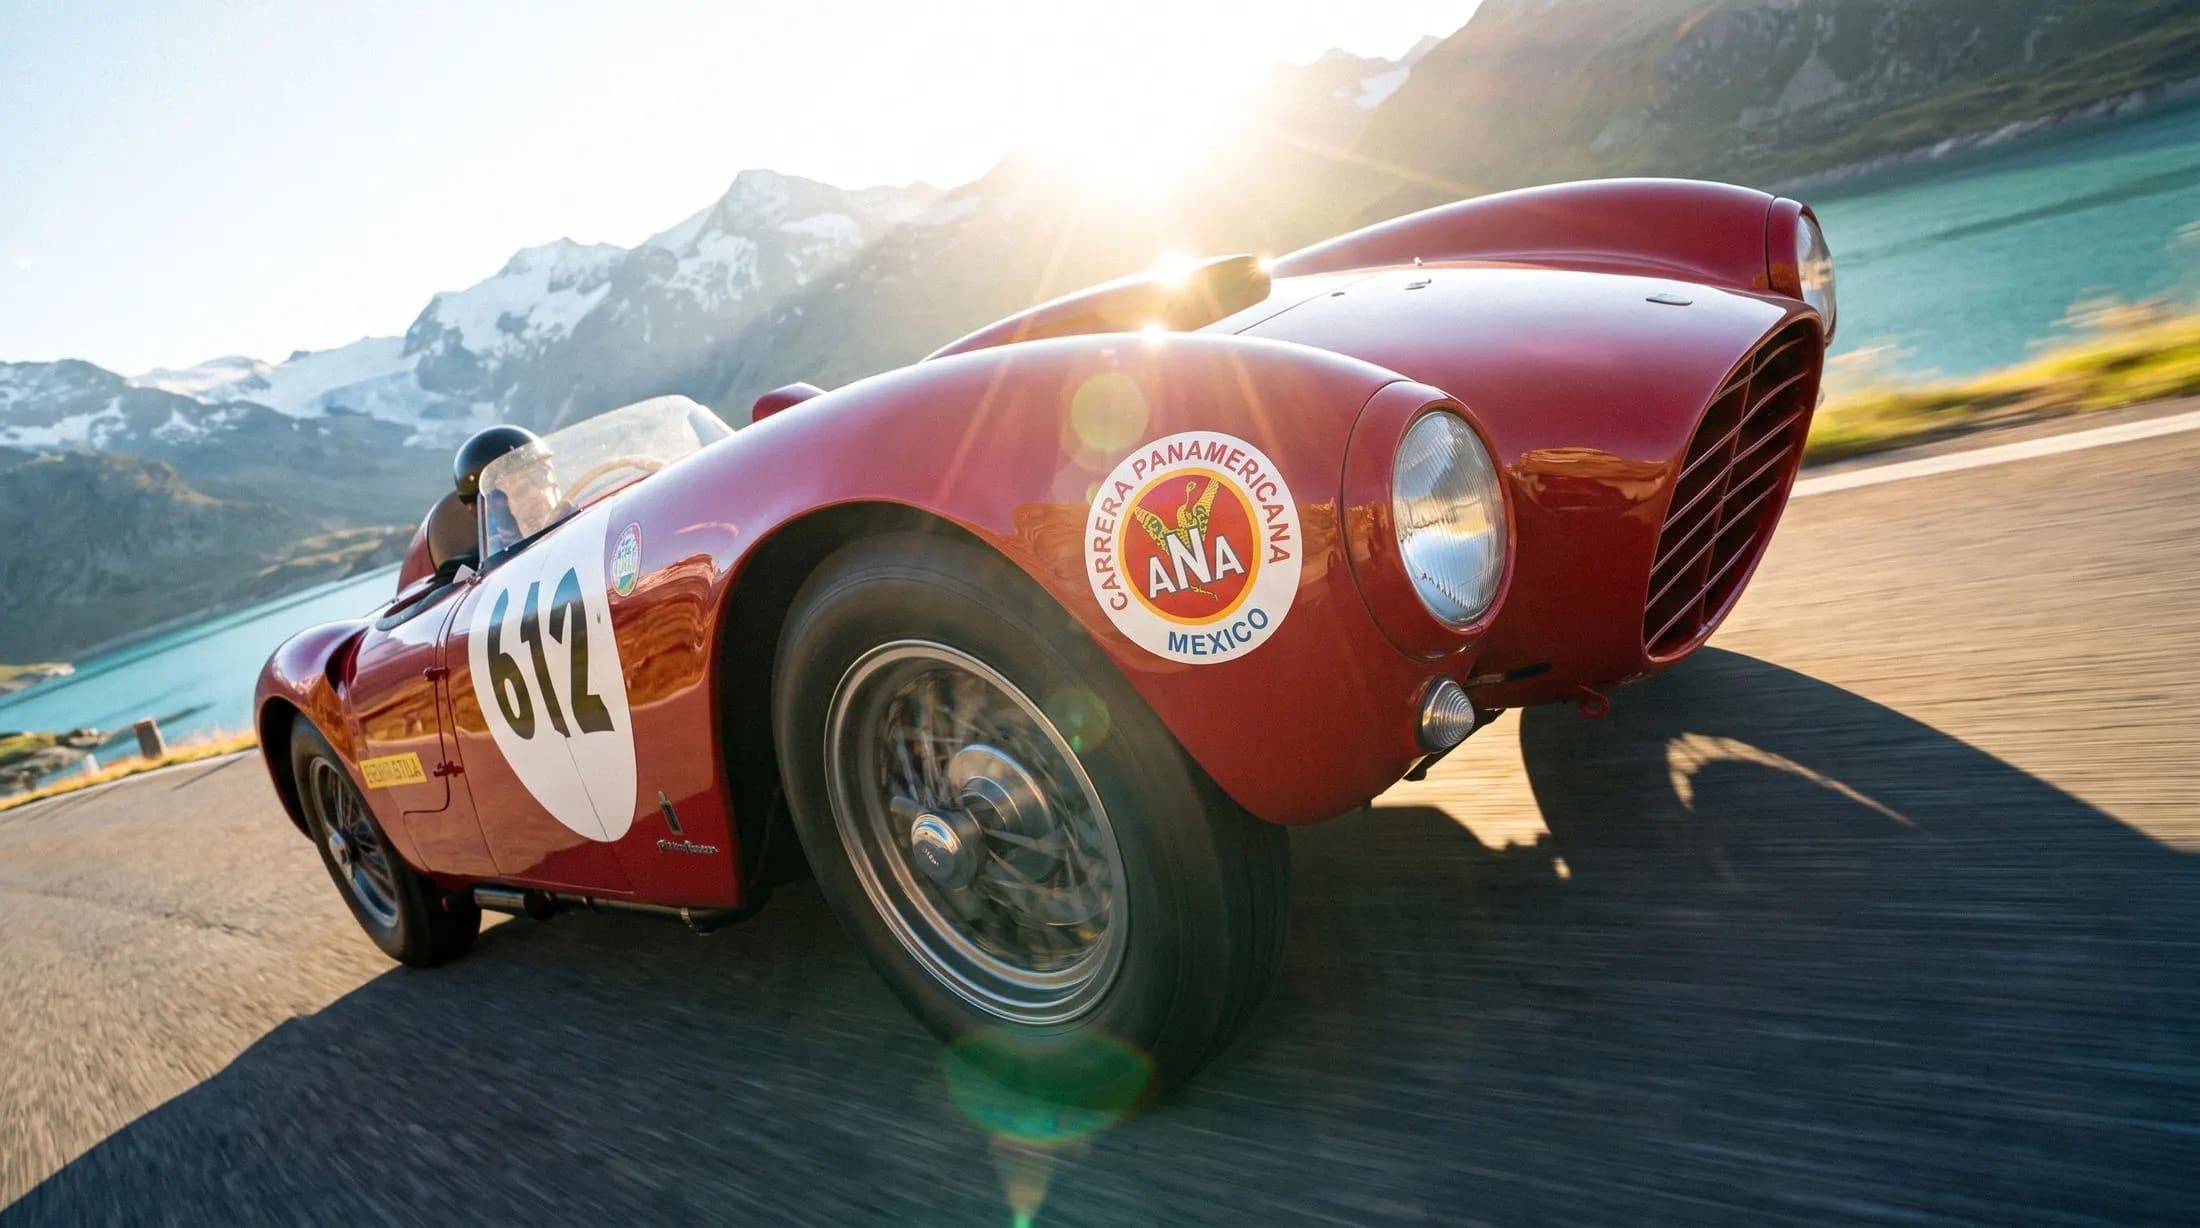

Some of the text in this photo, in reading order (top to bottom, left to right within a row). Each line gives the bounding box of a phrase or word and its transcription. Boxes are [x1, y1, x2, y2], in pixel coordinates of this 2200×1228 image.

[1093, 440, 1291, 611] CARRERA PANAMERICANA
[1147, 526, 1246, 600] ANA
[487, 566, 615, 741] 612
[1167, 607, 1269, 656] MEXICO
